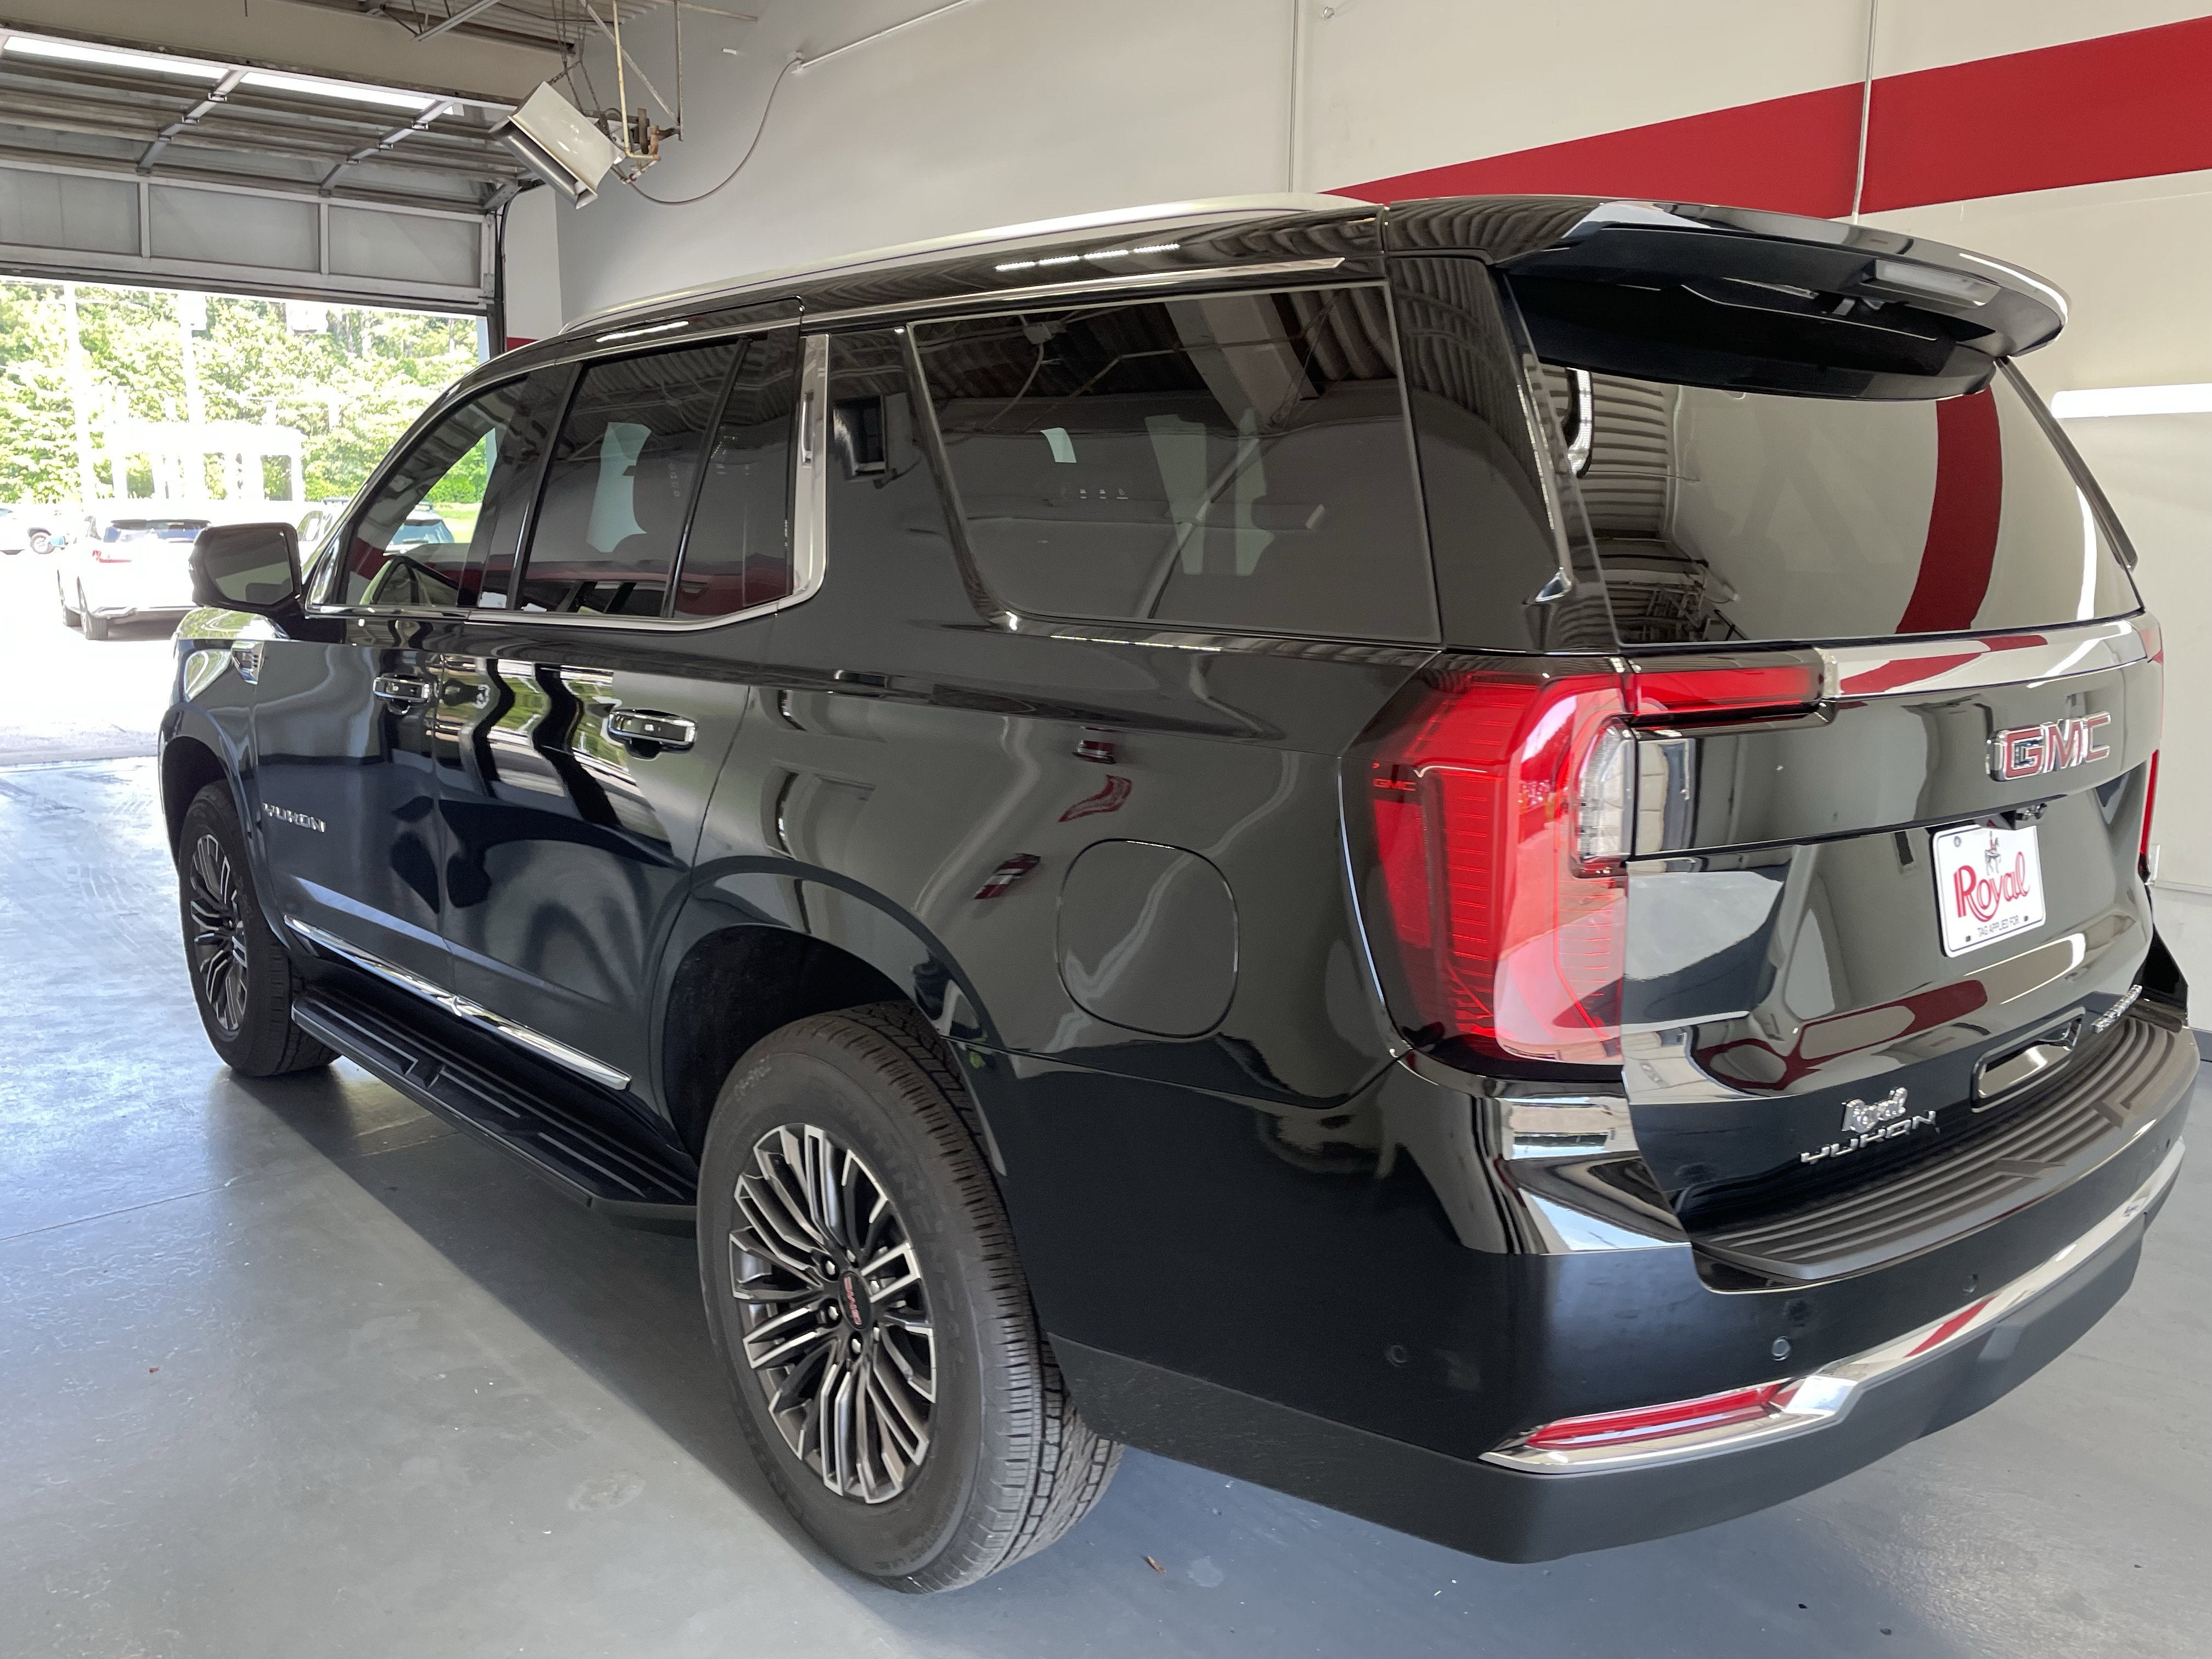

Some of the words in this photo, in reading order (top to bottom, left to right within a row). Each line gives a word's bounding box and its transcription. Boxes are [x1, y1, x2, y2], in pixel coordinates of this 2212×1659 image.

[1987, 711, 2112, 782] GMC
[1373, 778, 1417, 791] GMC
[263, 803, 326, 833] YUKON
[1953, 851, 2030, 922] Royal
[843, 1276, 862, 1325] GMC
